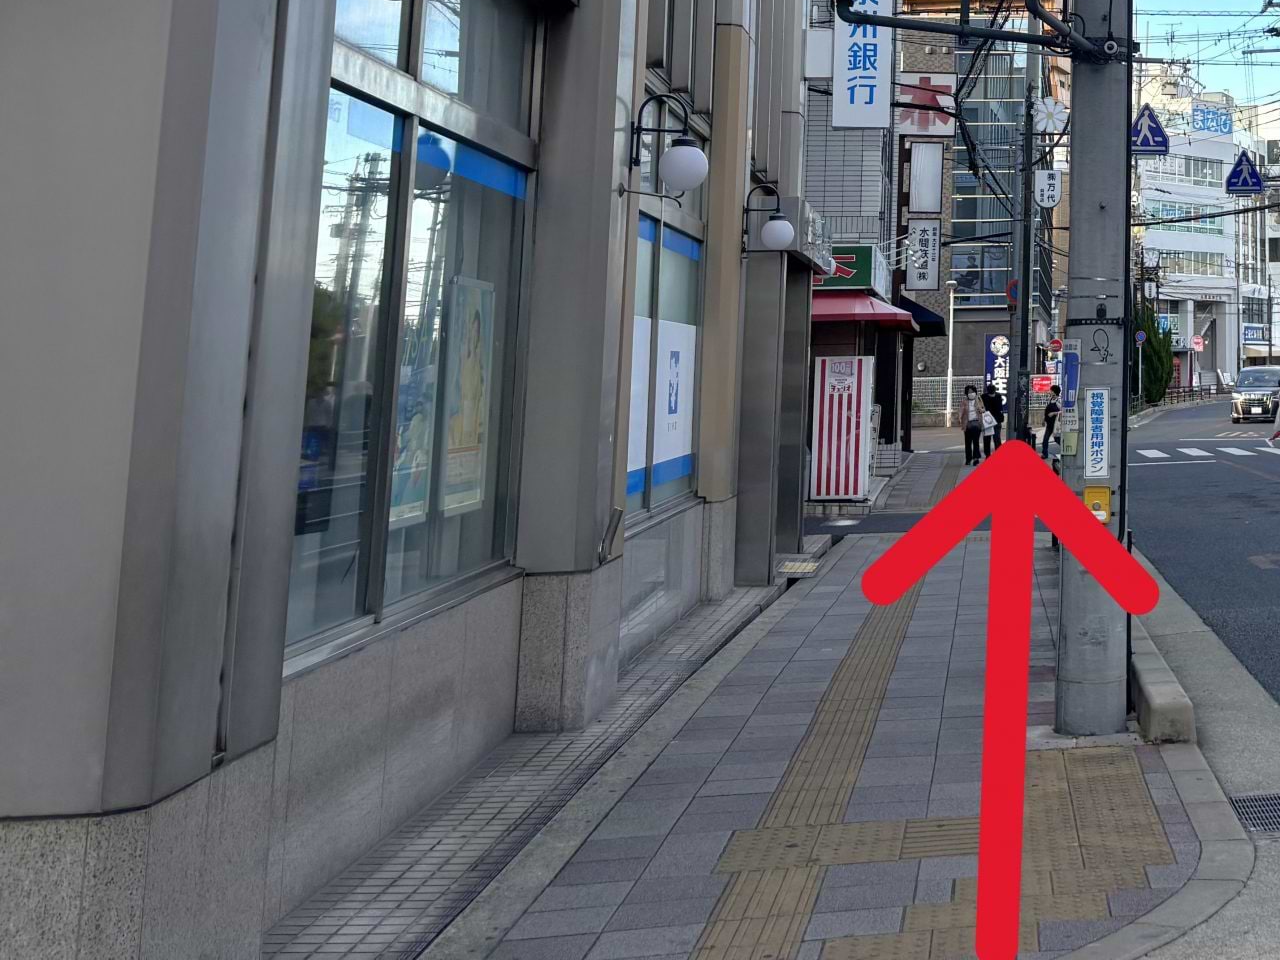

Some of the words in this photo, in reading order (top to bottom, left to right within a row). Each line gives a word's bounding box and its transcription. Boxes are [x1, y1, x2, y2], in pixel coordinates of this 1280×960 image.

[1090, 392, 1105, 474] 視覚障害者用押ボタン
